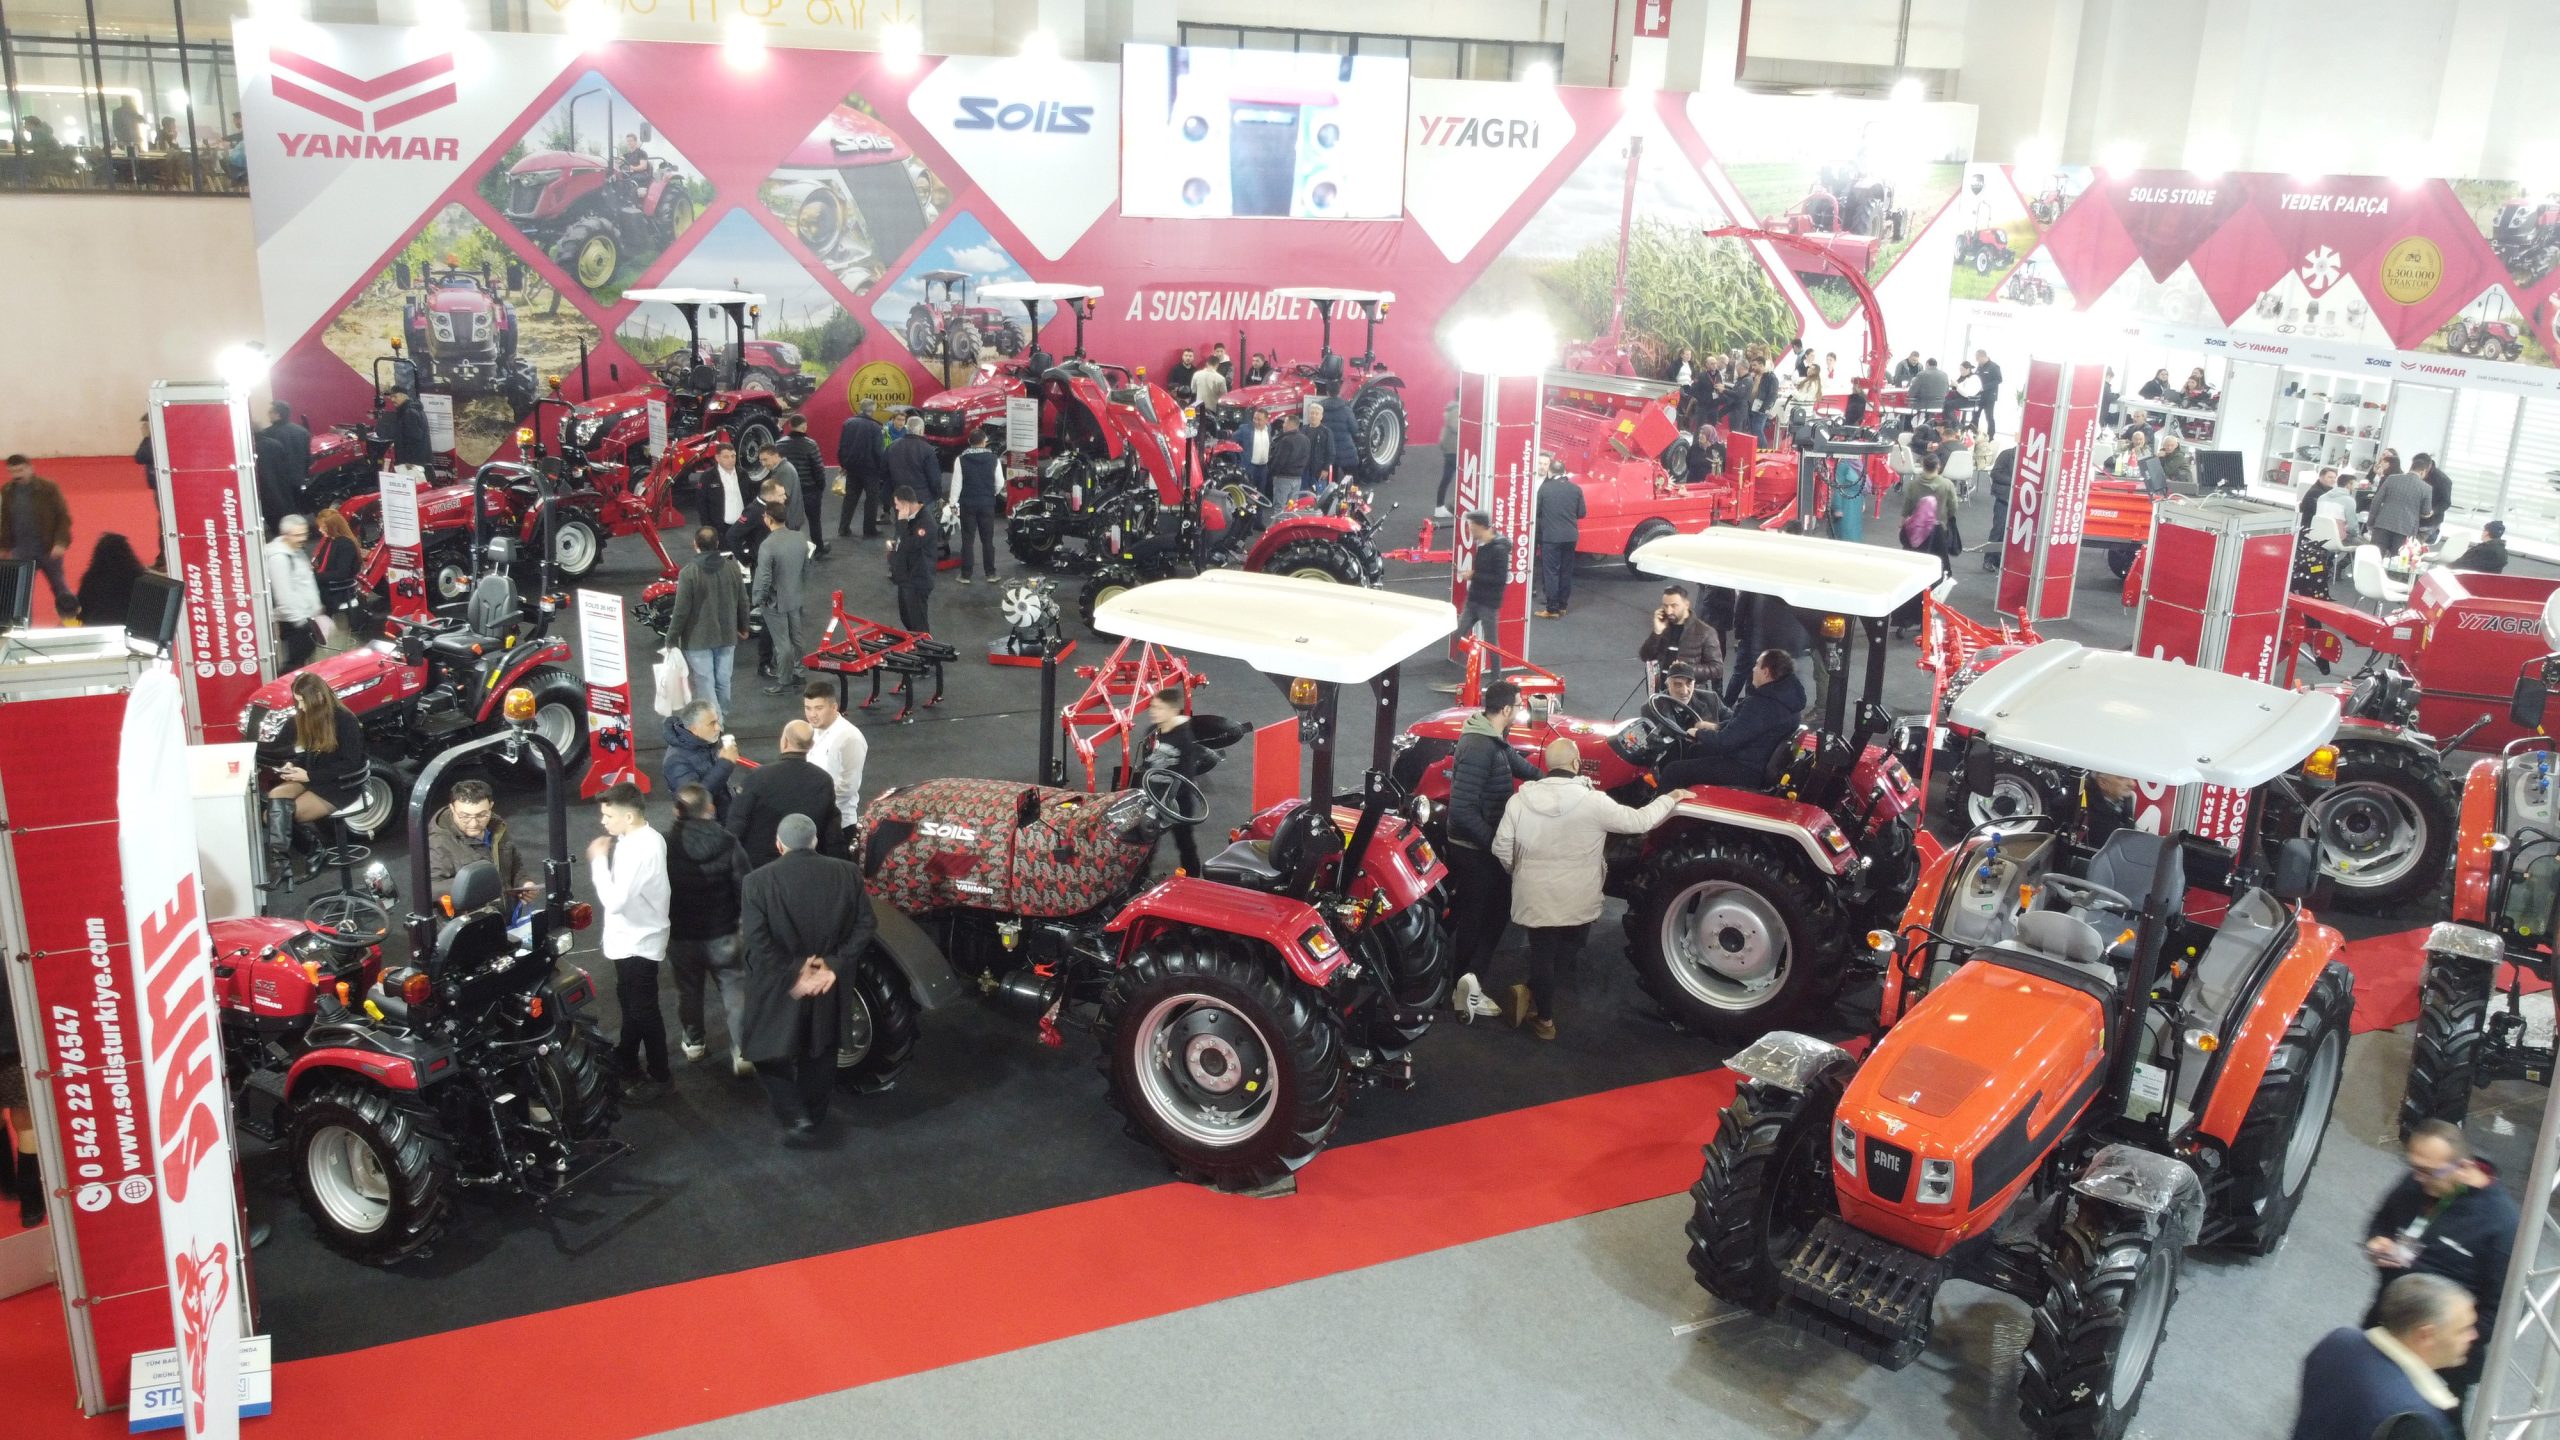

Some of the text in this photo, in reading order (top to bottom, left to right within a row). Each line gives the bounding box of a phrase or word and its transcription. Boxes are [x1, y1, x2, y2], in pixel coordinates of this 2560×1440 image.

[277, 132, 459, 161] YANMAR
[2128, 187, 2217, 206] SOLIS STORE
[2280, 193, 2389, 217] YEDEK PARÇA
[1125, 291, 1143, 321] A
[1149, 290, 1301, 321] SUSTAINABLE
[2249, 343, 2289, 355] YANMAR
[2419, 364, 2467, 378] YANMAR
[222, 488, 248, 608] solistraktorturkiye
[188, 564, 204, 603] 76547
[204, 518, 231, 658] www.solisturkiye.com
[193, 606, 207, 624] 22
[2458, 611, 2543, 636] YTAGRI
[196, 628, 210, 649] 542
[956, 884, 994, 895] YANMAR
[86, 917, 142, 1172] www.solisturkiye.com
[141, 872, 220, 1204] SAME
[52, 1005, 104, 1178] 0 542 22 76547
[1874, 1149, 1901, 1173] SAME
